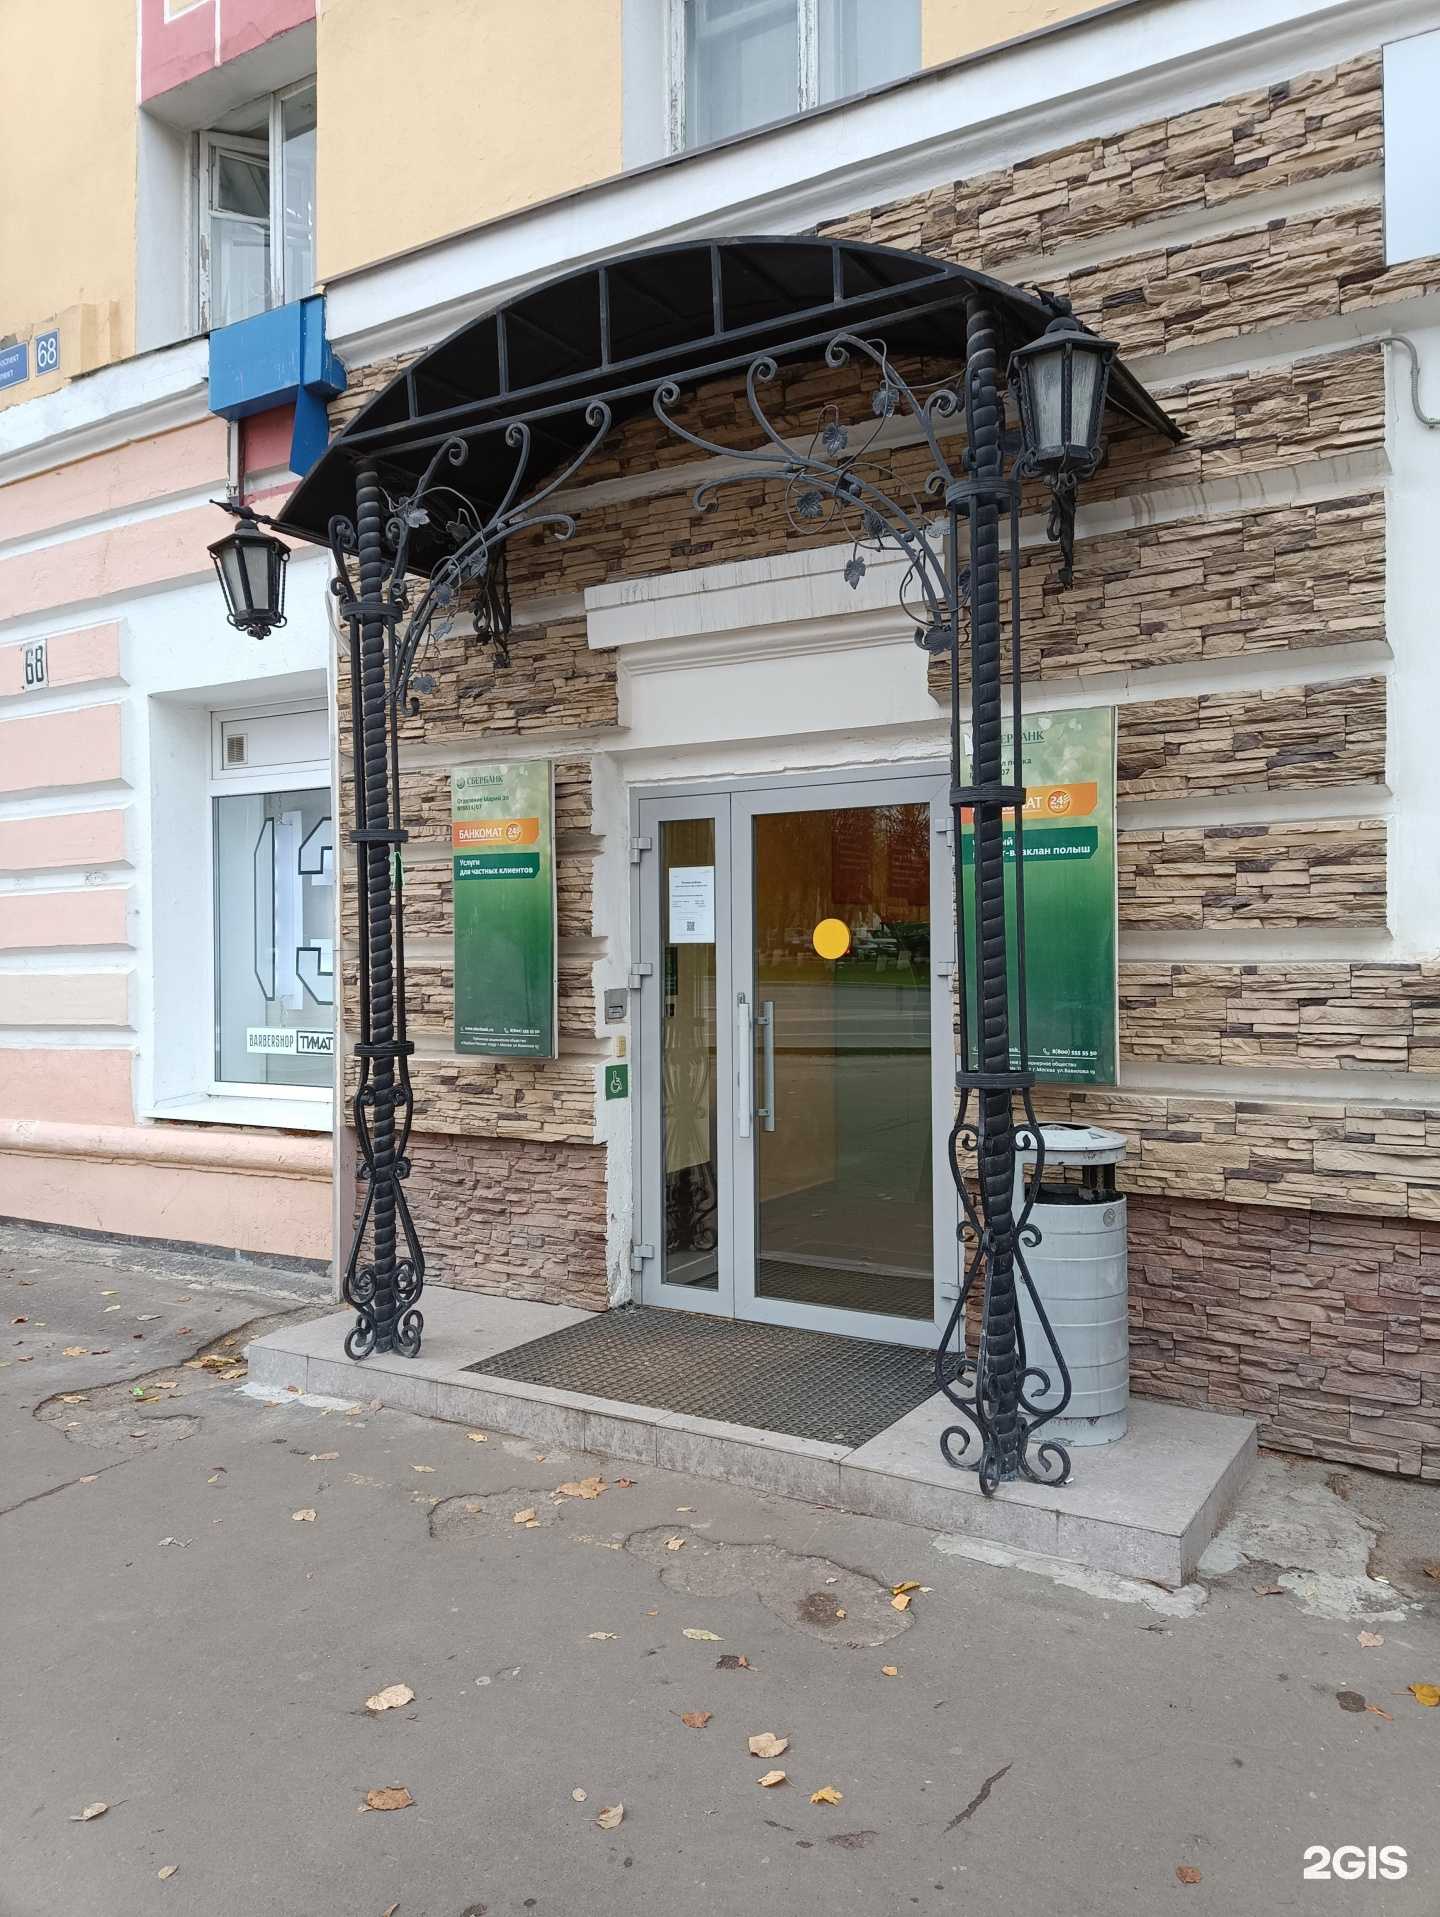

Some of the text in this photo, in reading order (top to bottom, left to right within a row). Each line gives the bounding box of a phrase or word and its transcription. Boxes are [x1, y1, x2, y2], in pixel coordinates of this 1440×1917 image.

[38, 338, 57, 367] 68
[25, 645, 44, 685] 68
[459, 827, 503, 839] БАНКОМАТ
[1053, 845, 1091, 855] полыш
[459, 859, 480, 868] Услуги
[472, 867, 498, 876] частных
[499, 866, 533, 875] клиентов
[249, 1034, 294, 1048] BARBERSHOP
